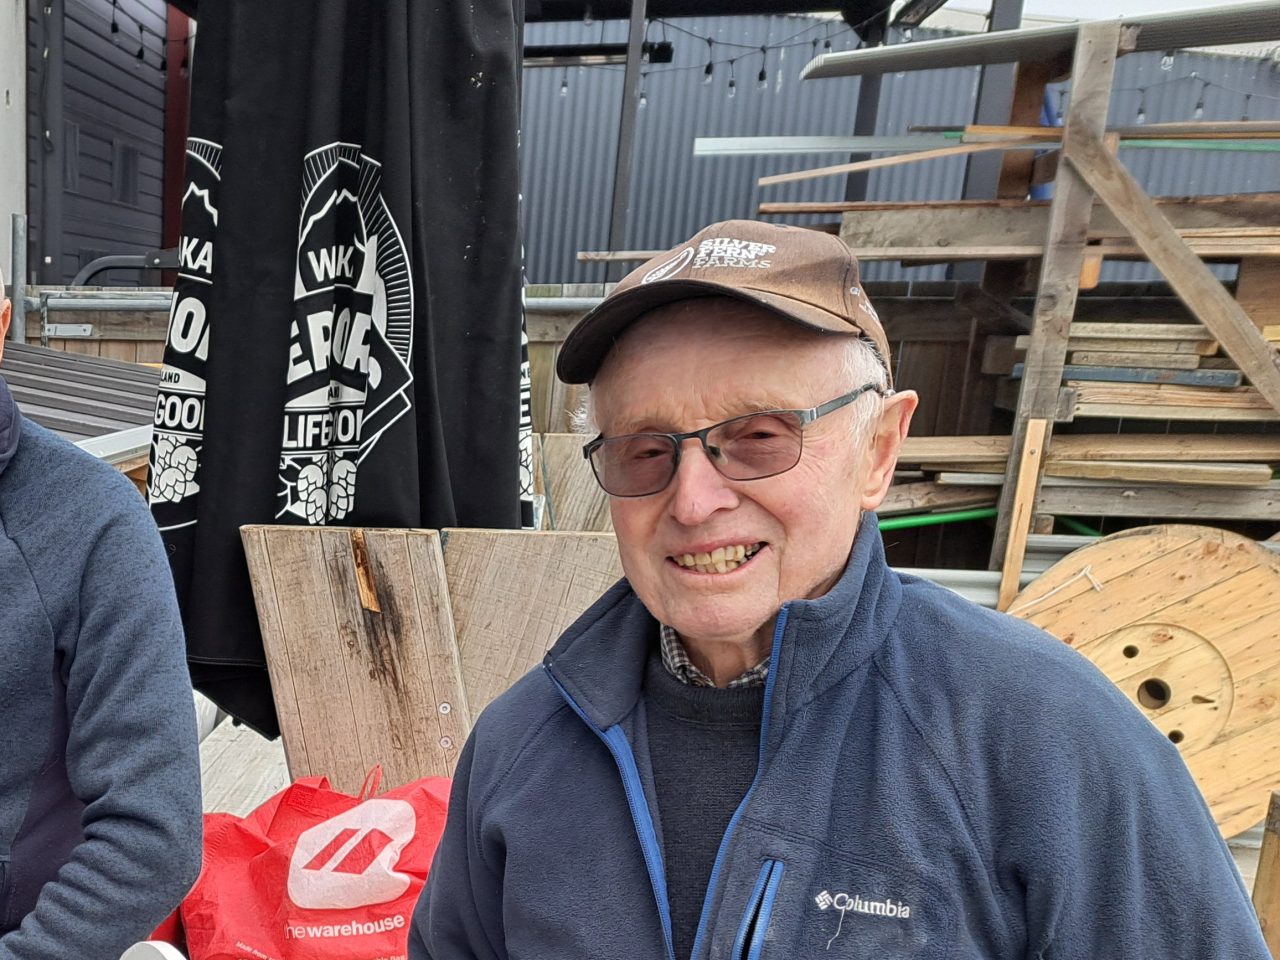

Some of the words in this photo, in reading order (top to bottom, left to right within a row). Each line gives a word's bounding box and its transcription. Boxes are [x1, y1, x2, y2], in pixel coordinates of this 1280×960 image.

[697, 246, 757, 259] FERN
[699, 238, 776, 253] SILVER
[692, 256, 772, 268] FARMS
[154, 393, 205, 431] GOO
[833, 893, 910, 918] Columbia
